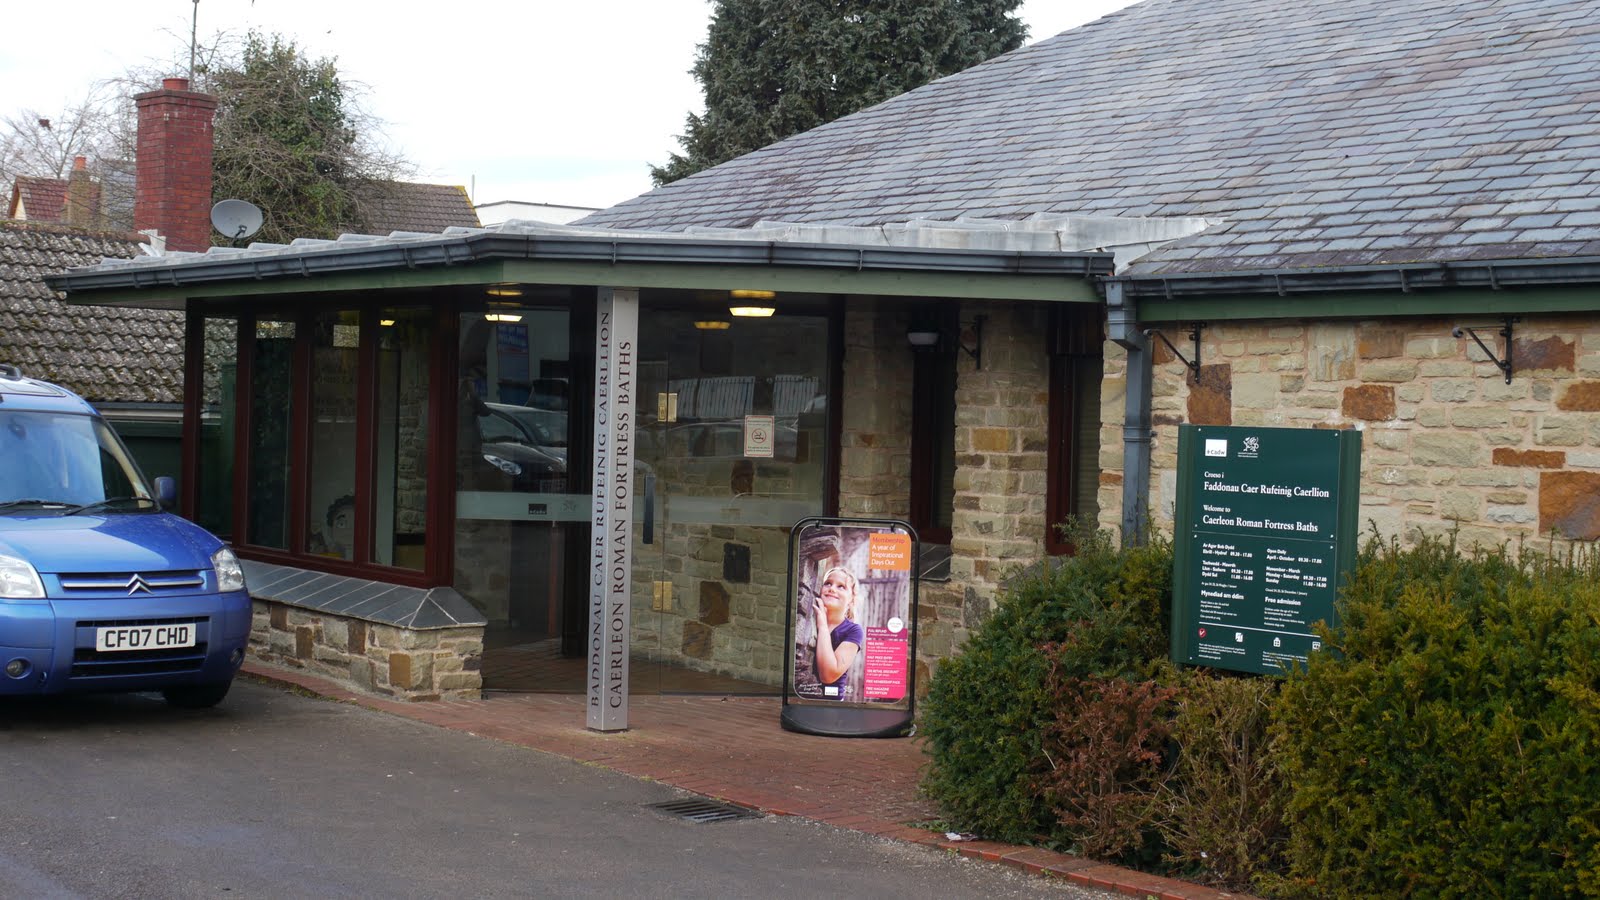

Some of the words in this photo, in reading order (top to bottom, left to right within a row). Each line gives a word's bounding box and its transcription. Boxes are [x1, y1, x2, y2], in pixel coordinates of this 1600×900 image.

[599, 312, 609, 425] CAERLLION
[618, 341, 631, 405] BATHS
[596, 433, 606, 526] RUFEINIG
[615, 412, 629, 510] FORTRESS
[1204, 481, 1239, 493] Faddonau
[1241, 483, 1258, 494] Caer
[1260, 485, 1292, 497] Rufeinig
[1294, 486, 1330, 498] Caerllion
[1202, 514, 1235, 526] Caerleon
[1236, 517, 1263, 528] Roman
[1264, 519, 1294, 531] Fortress
[1296, 521, 1318, 532] Baths
[1203, 504, 1224, 512] Welcome
[594, 536, 604, 586] CAER
[613, 518, 626, 593] ROMAN
[872, 551, 904, 559] Inspirational
[872, 558, 885, 566] Days
[105, 629, 152, 648] CF07
[155, 627, 188, 646] CHD
[591, 594, 602, 706] BADDONAU
[610, 602, 624, 708] CAERLEON
